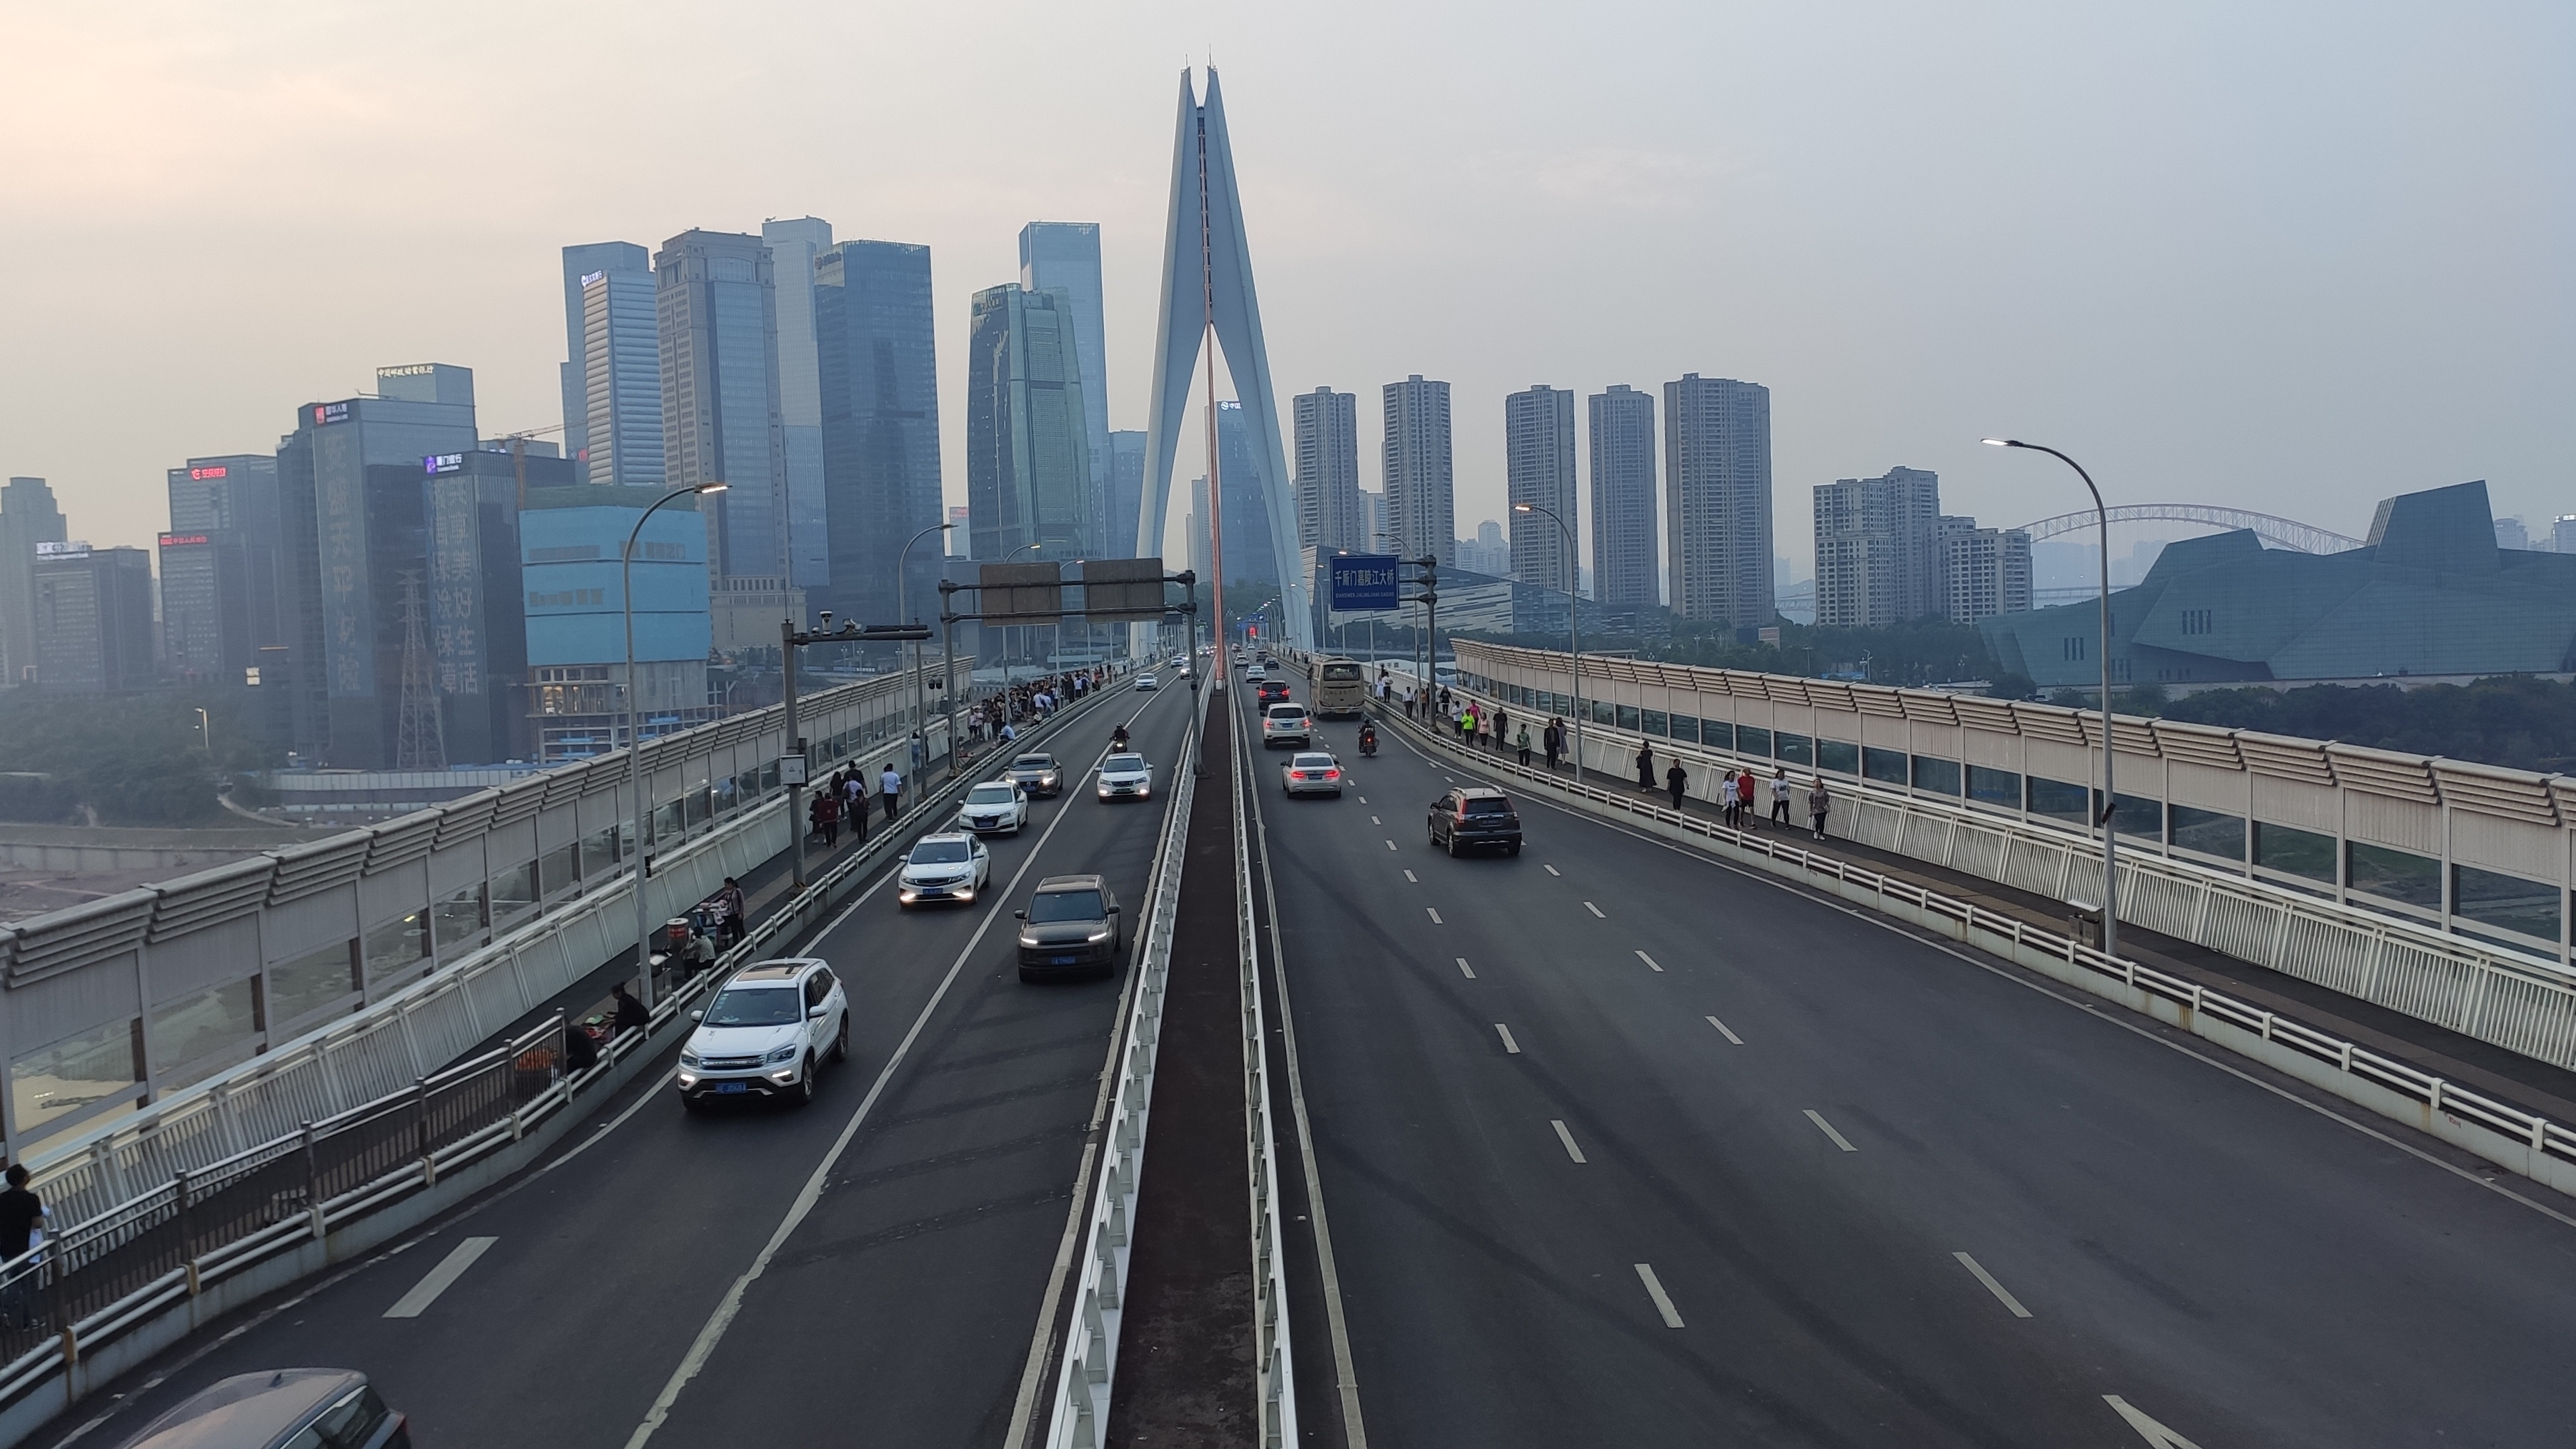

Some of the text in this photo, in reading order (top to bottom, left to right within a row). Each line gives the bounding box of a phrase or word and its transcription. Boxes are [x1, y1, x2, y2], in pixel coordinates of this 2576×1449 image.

[1334, 569, 1395, 587] 千厮门嘉陵江大桥
